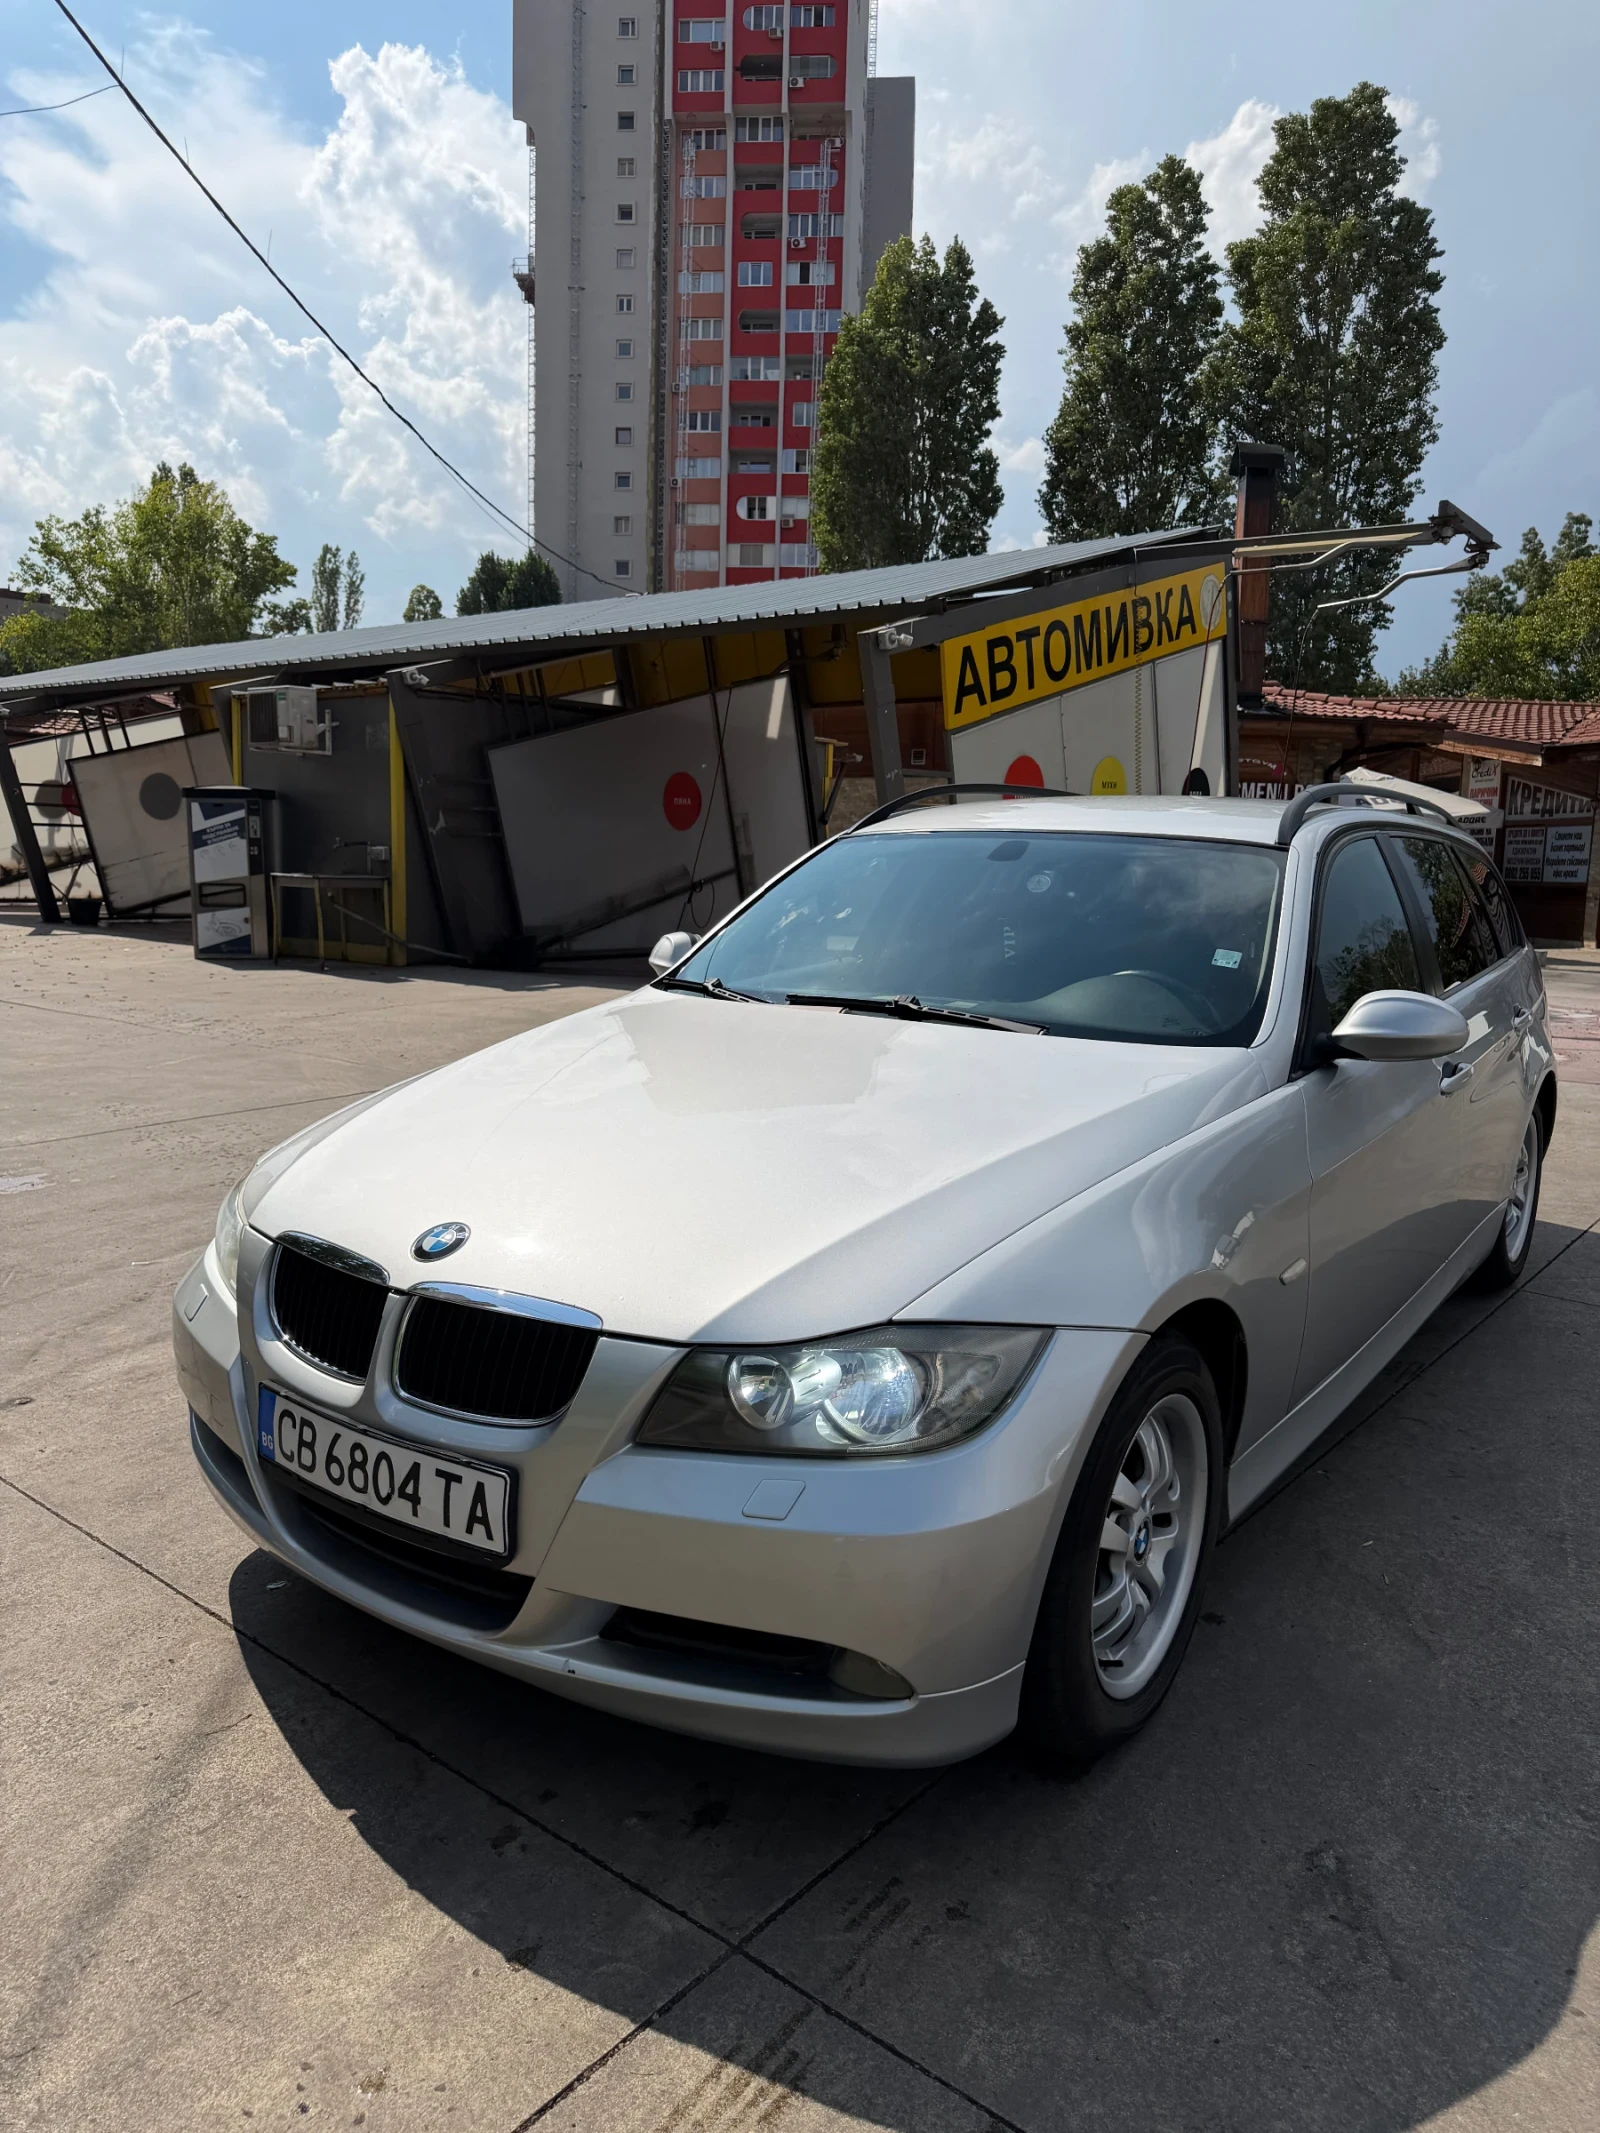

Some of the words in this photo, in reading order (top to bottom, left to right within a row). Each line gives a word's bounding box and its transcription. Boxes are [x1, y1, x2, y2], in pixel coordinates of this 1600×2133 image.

[954, 583, 1197, 715] АВТОМИВКА
[1508, 779, 1592, 817] КРЕДИТИ
[261, 1431, 274, 1450] BG
[278, 1408, 317, 1474] CB
[325, 1432, 422, 1518] 6804
[435, 1467, 494, 1542] TA
